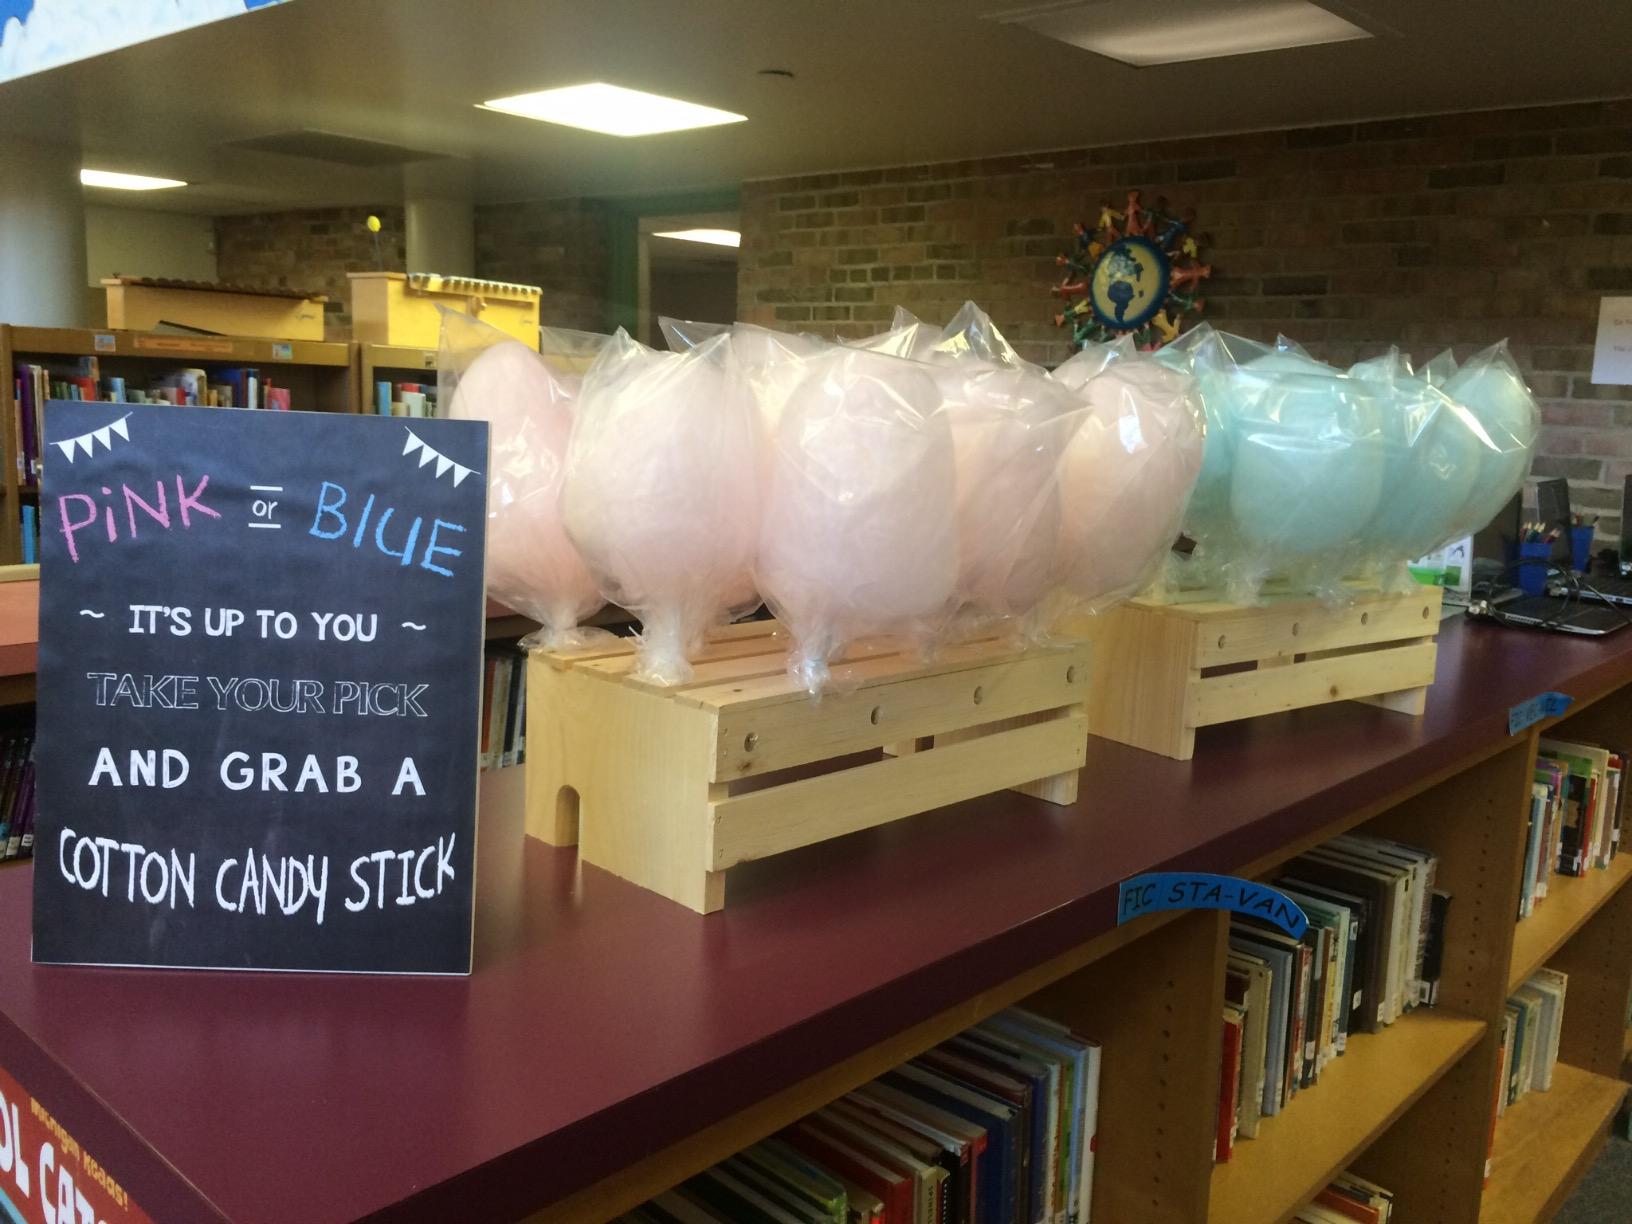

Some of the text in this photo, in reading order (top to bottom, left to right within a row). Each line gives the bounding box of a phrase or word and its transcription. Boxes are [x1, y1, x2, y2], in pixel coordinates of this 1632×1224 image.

[252, 498, 278, 521] or
[129, 604, 378, 642] IT'S UP TO YOU
[87, 672, 429, 718] TAKE YOUR PICK
[88, 747, 426, 796] AND GRAB A
[59, 826, 457, 925] COTTON CANDY STICK
[1122, 881, 1300, 929] FIC STA-VAN
